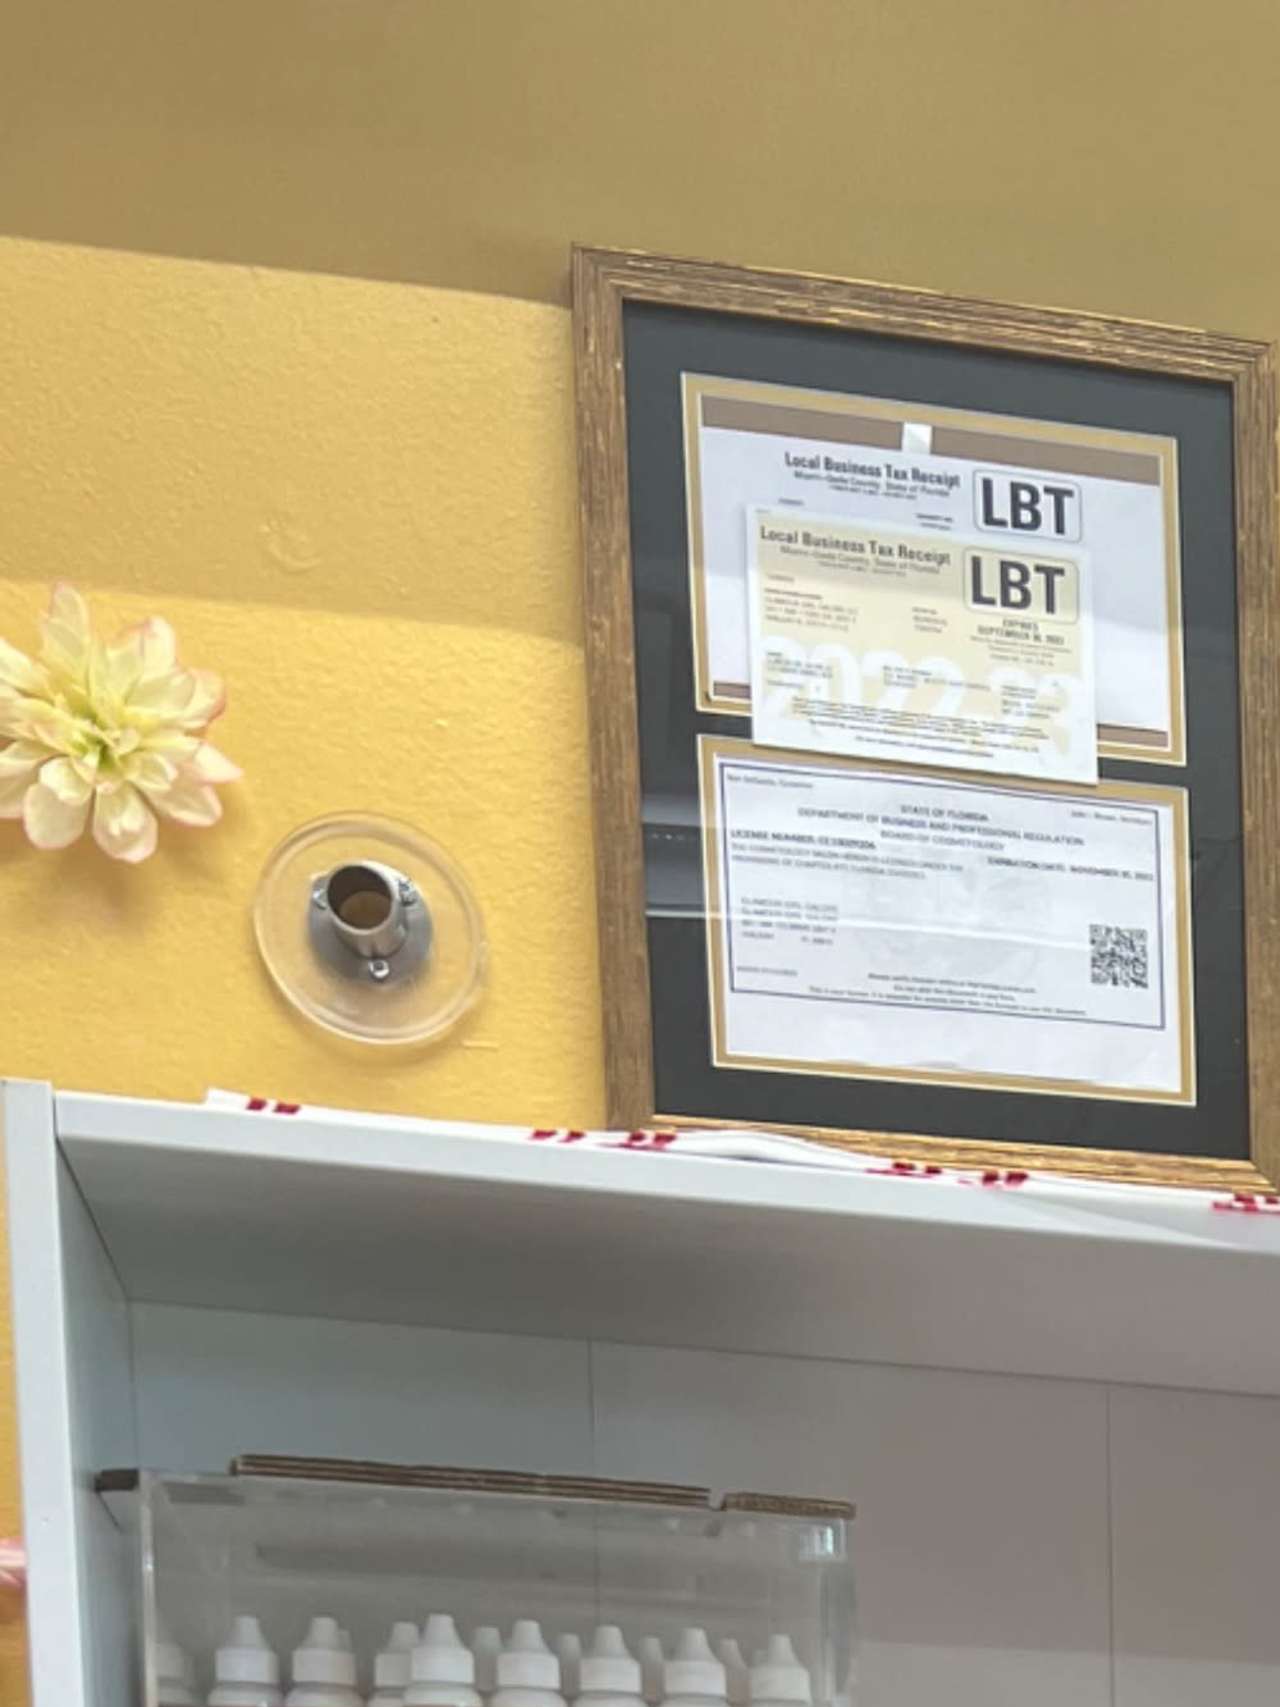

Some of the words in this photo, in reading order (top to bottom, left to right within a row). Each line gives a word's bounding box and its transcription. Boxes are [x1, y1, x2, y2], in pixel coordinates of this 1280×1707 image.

[784, 452, 820, 469] Local
[824, 456, 881, 477] Business
[885, 464, 908, 481] Tax
[911, 468, 960, 488] Receipt
[982, 477, 1074, 535] LBT
[760, 526, 798, 543] Local
[802, 531, 865, 553] Business
[869, 541, 894, 556] Tax
[898, 544, 950, 566] Receipt
[970, 555, 1065, 614] LBT
